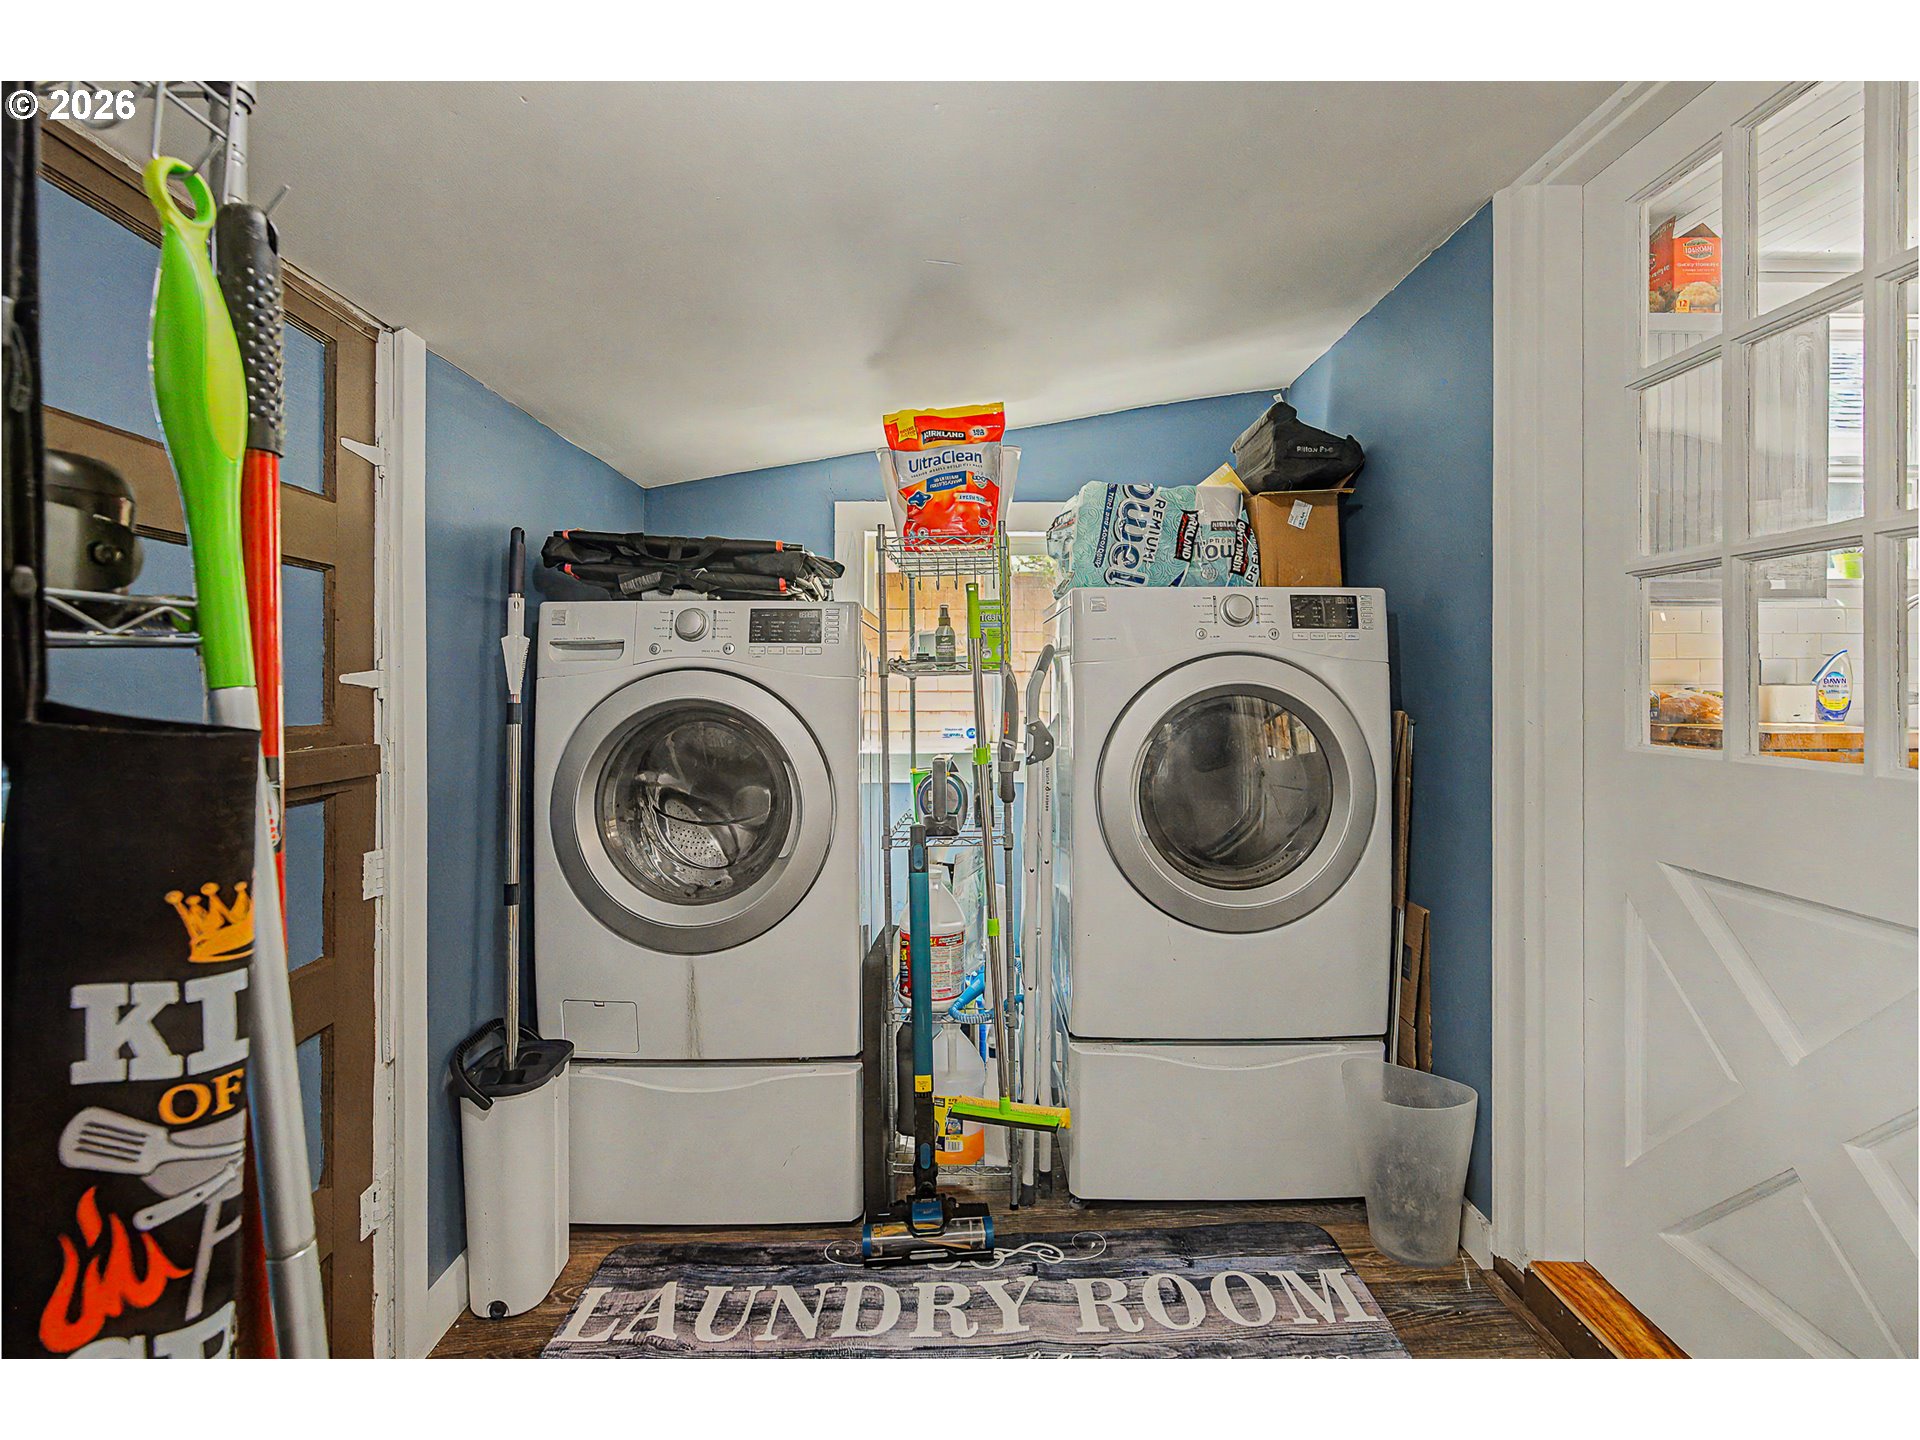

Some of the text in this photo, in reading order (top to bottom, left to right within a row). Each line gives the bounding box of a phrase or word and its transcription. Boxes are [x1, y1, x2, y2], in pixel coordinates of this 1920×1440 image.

[908, 450, 982, 473] UltraClean
[924, 430, 964, 440] KIRKLAND
[1143, 498, 1166, 563] REMIUM
[1232, 521, 1246, 572] KIRKLAND
[69, 967, 249, 1086] KI
[158, 1068, 245, 1125] OF
[551, 1268, 1380, 1343] LAUNDRY ROOM
